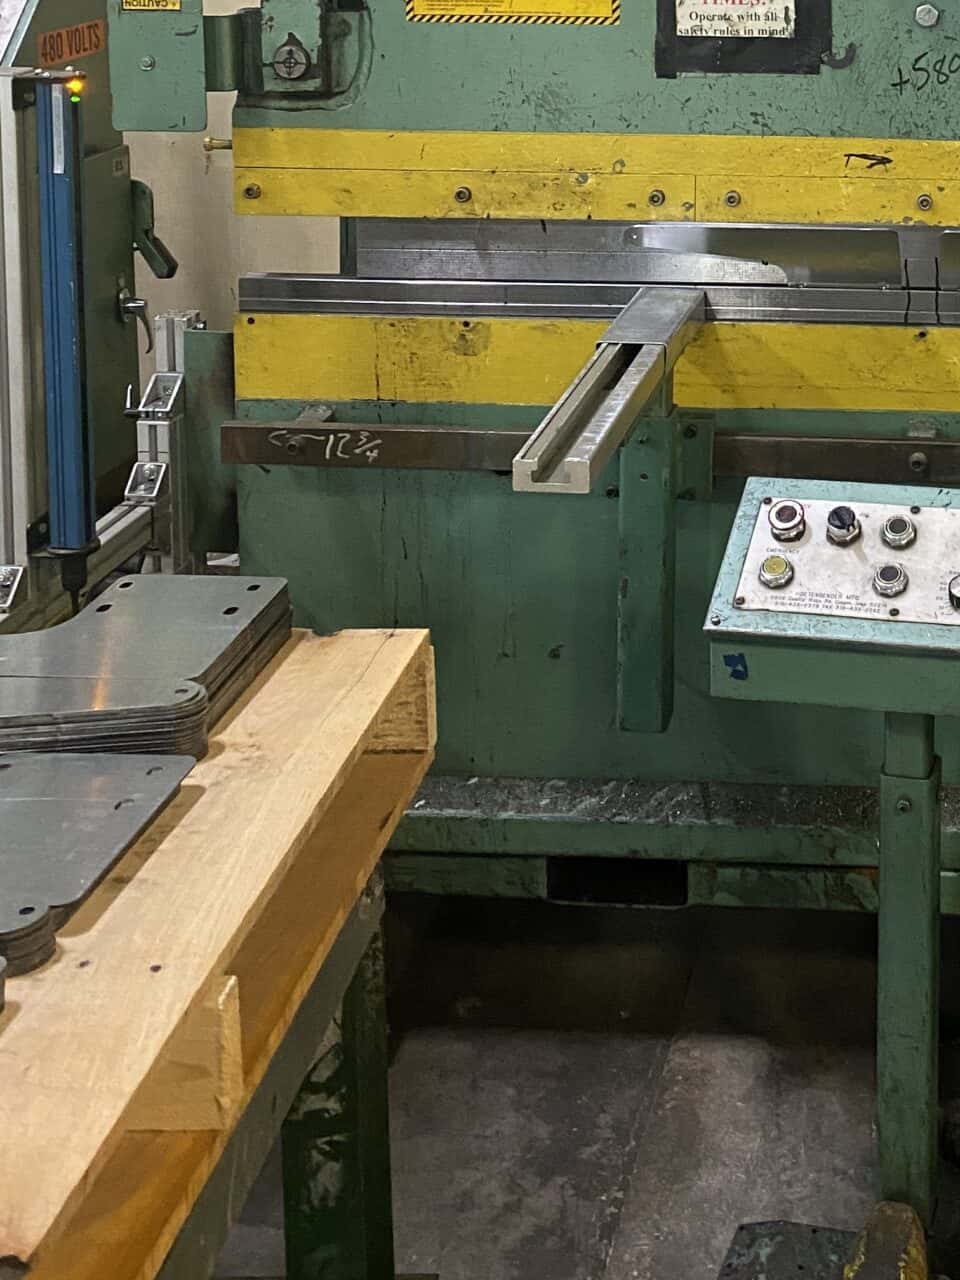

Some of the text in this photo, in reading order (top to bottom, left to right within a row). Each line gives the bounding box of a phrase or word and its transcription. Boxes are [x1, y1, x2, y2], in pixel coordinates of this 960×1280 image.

[124, 0, 168, 7] CAUTION
[689, 11, 734, 23] Operate
[737, 11, 760, 22] with
[744, 26, 754, 36] in
[41, 23, 100, 62] 480 VOLTS
